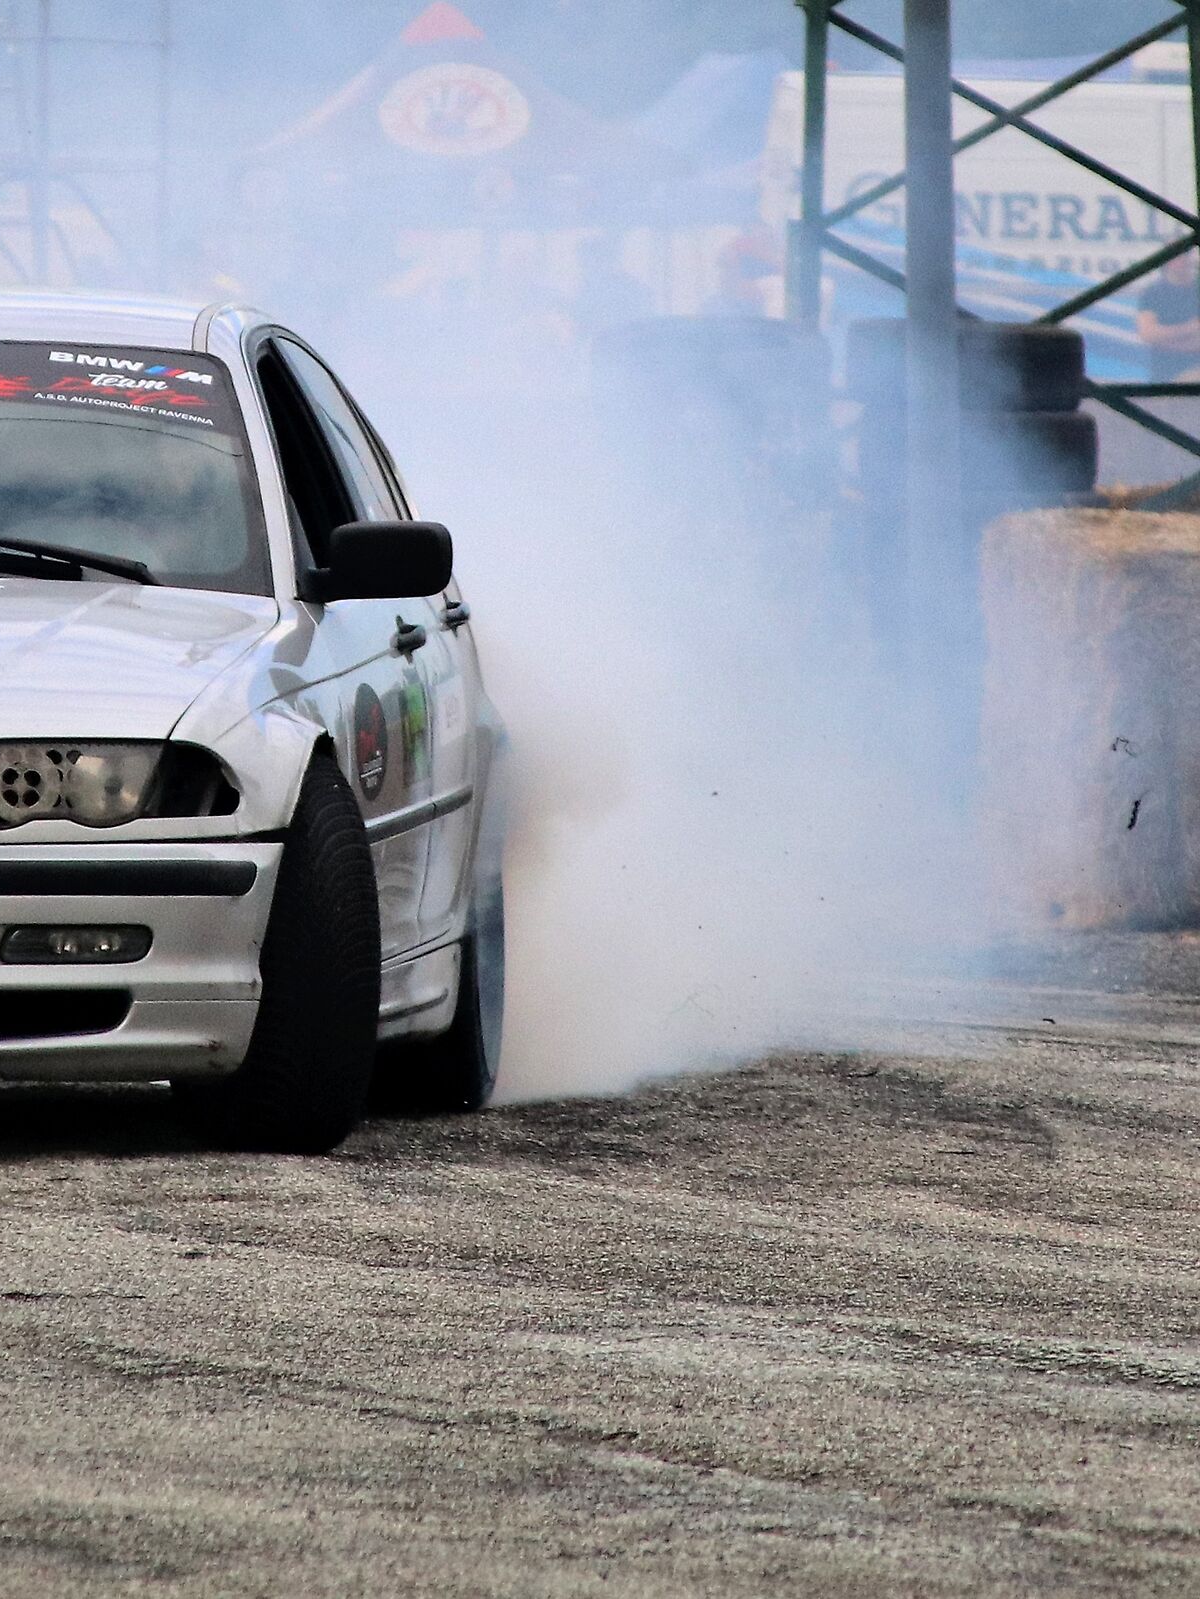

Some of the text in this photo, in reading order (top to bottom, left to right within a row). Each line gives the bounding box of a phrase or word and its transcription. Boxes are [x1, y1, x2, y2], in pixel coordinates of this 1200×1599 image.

[49, 351, 144, 372] BMW
[70, 396, 158, 414] AUTOPROJECT
[158, 408, 214, 426] RAVENNA
